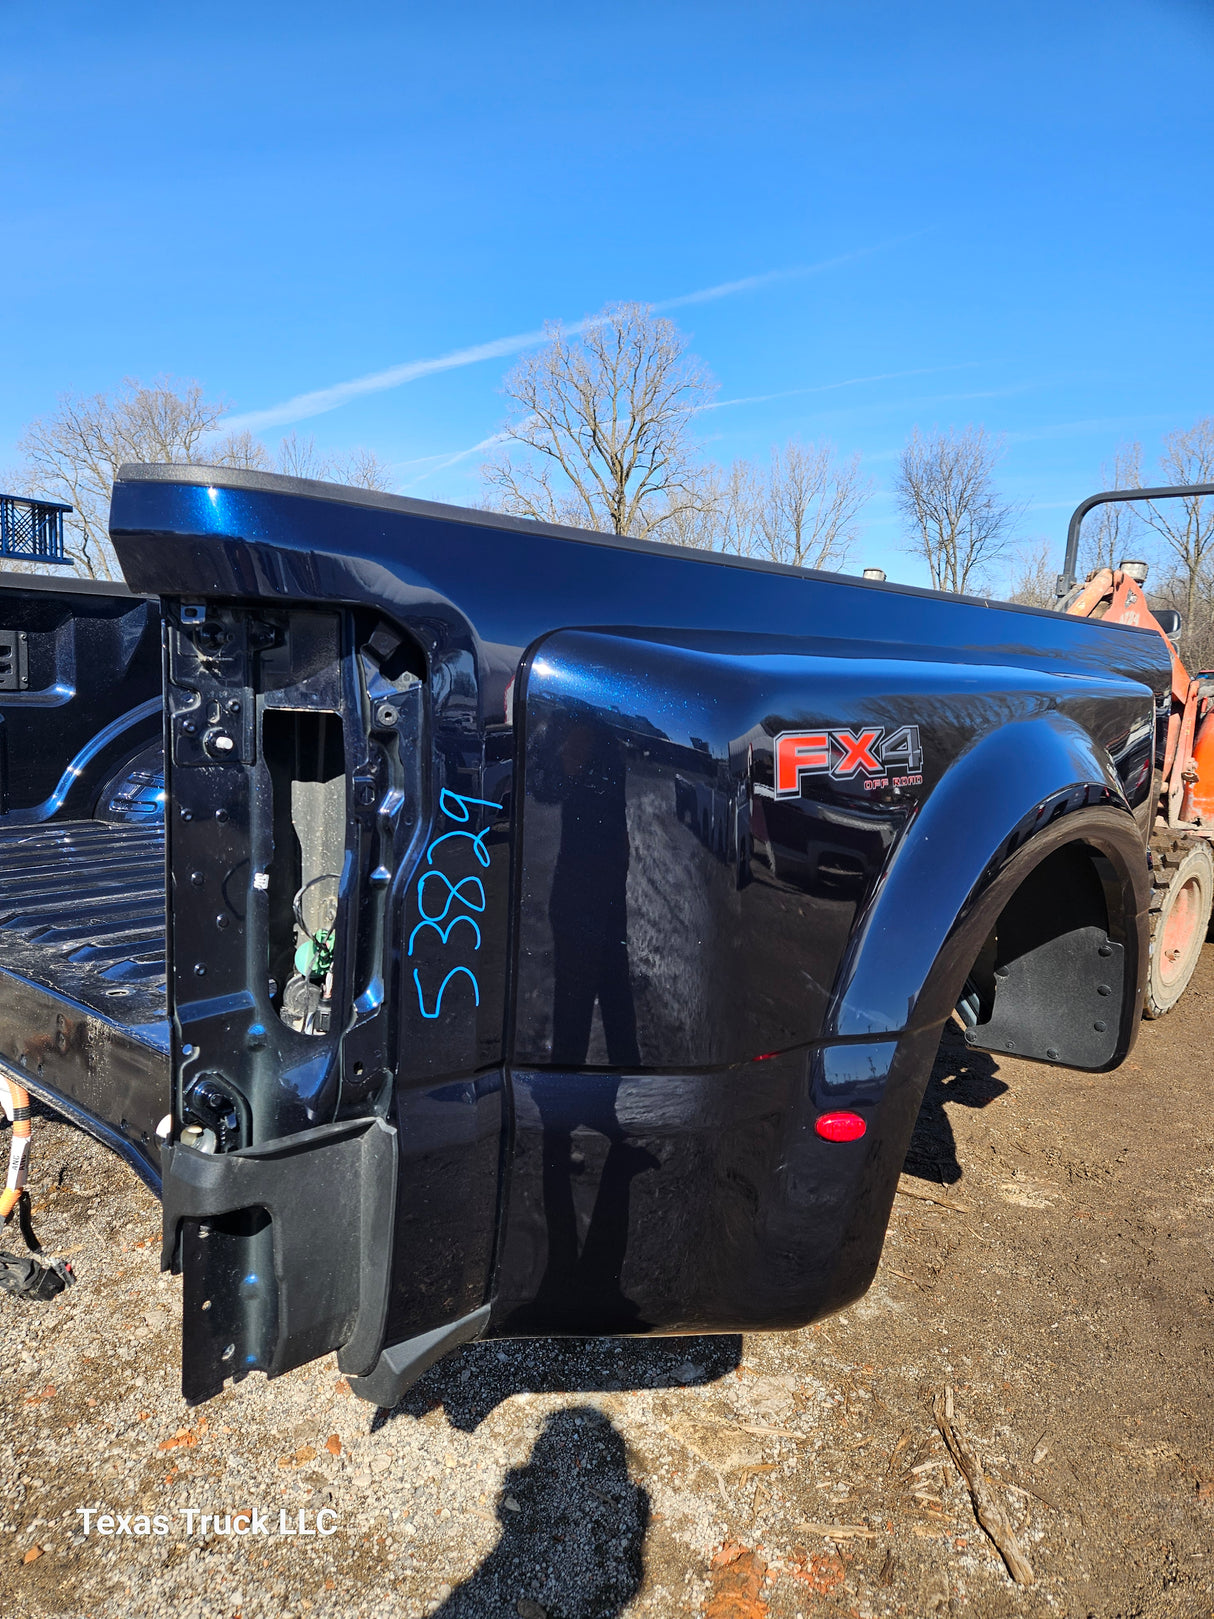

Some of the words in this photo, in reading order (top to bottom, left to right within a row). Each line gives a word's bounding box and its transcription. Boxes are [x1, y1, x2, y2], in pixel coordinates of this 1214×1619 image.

[774, 725, 923, 800] FX4
[863, 777, 889, 790] OFF
[893, 775, 923, 788] ROAD
[407, 787, 503, 1018] 53829
